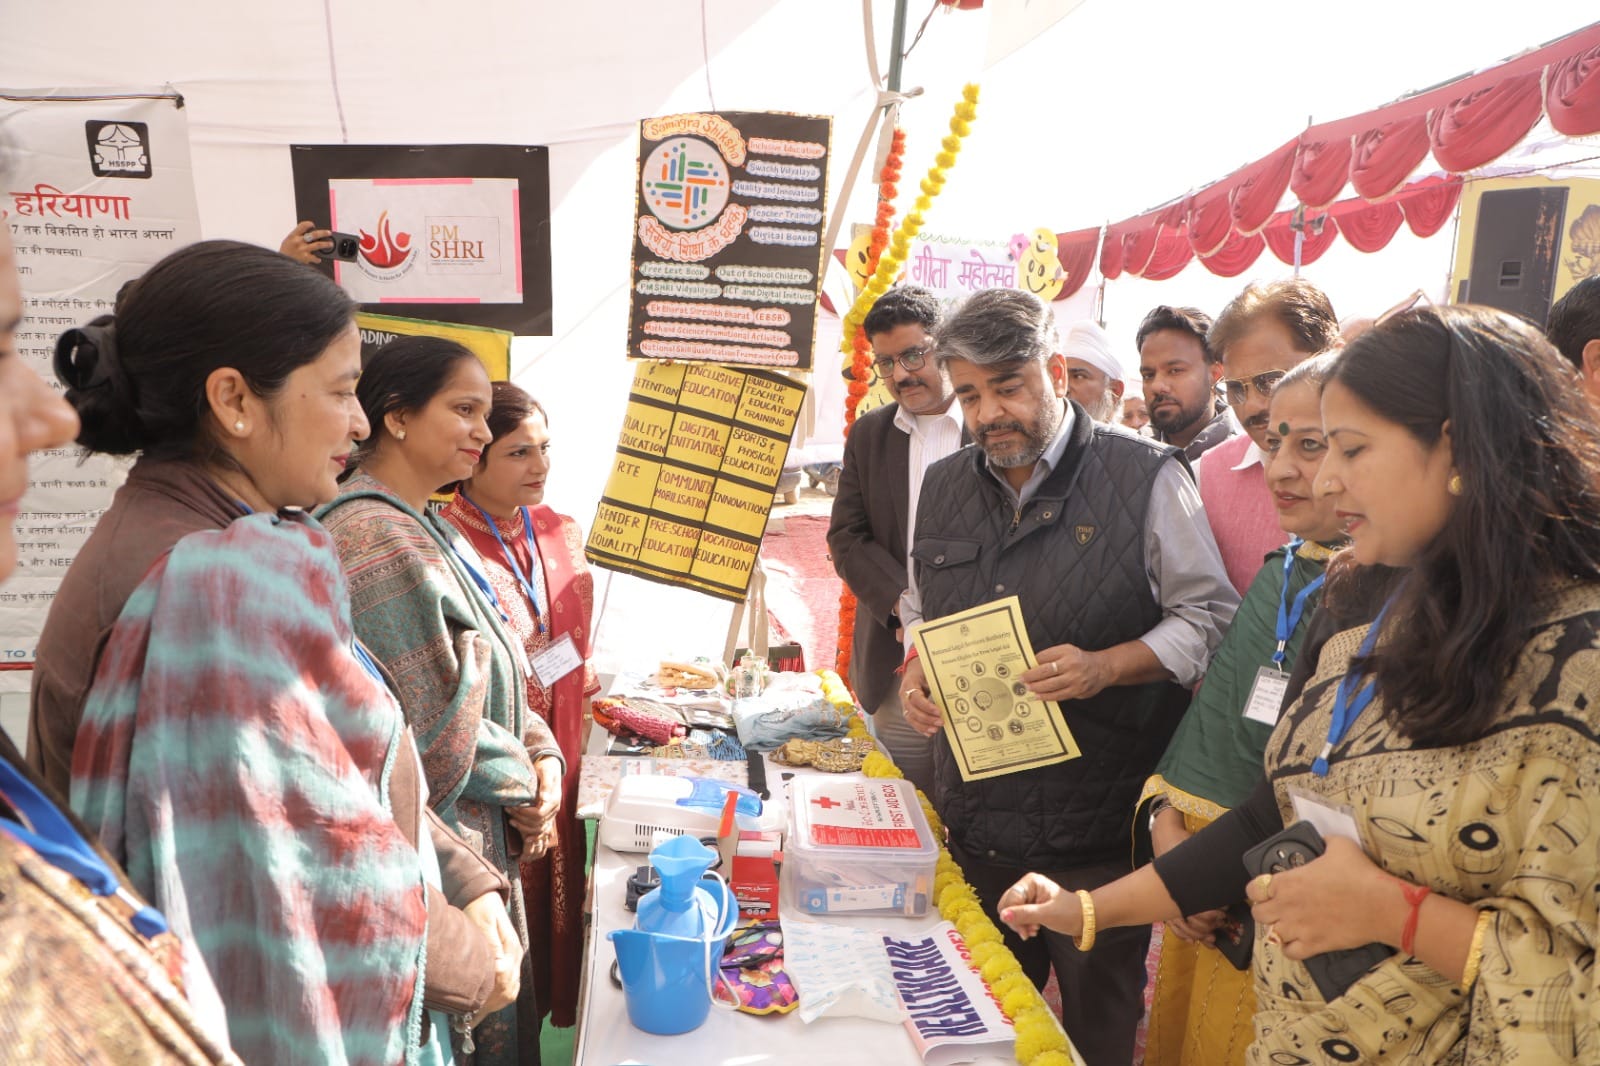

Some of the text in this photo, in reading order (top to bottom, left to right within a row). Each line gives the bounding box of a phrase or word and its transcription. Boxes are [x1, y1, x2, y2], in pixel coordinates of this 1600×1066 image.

[107, 160, 137, 168] HSSPP
[9, 183, 132, 220] हरियाणा
[752, 208, 818, 220] Teacher Training
[23, 225, 42, 236] तक
[45, 223, 89, 238] विकसित
[92, 225, 105, 241] हो
[109, 228, 138, 240] भारत
[430, 225, 459, 241] PM
[752, 230, 784, 240] Digital
[31, 244, 42, 256] की
[430, 240, 486, 259] SHRI
[720, 269, 808, 281] Out of School Children
[912, 244, 1016, 291] गीता महोत्सव
[742, 288, 756, 297] and
[756, 289, 781, 299] Digital
[755, 312, 786, 322] (EBSB)
[687, 365, 742, 388] INCLUSIVE
[747, 375, 788, 393] BUILD UP
[681, 380, 740, 406] EDUCATION
[746, 386, 785, 405] TEACHER
[743, 408, 785, 427] TRAINING
[748, 397, 799, 419] EDUCATION
[678, 420, 721, 443] DIGITAL
[732, 428, 769, 448] SPORTS
[737, 445, 776, 466] PHYSICAL
[616, 459, 641, 478] RTE
[723, 455, 779, 479] EDUCATION
[712, 491, 770, 516] INNOVATIONS
[599, 506, 641, 529] GENDER
[602, 524, 624, 535] AND
[590, 532, 640, 557] EQUALITY
[642, 537, 696, 559] EDUCATION
[702, 530, 757, 555] VOCATIONAL
[695, 548, 751, 573] EDUCATION
[6, 650, 26, 658] TO
[881, 784, 906, 828] FIRST AID BOX
[882, 936, 989, 1040] HEALTHCARE
